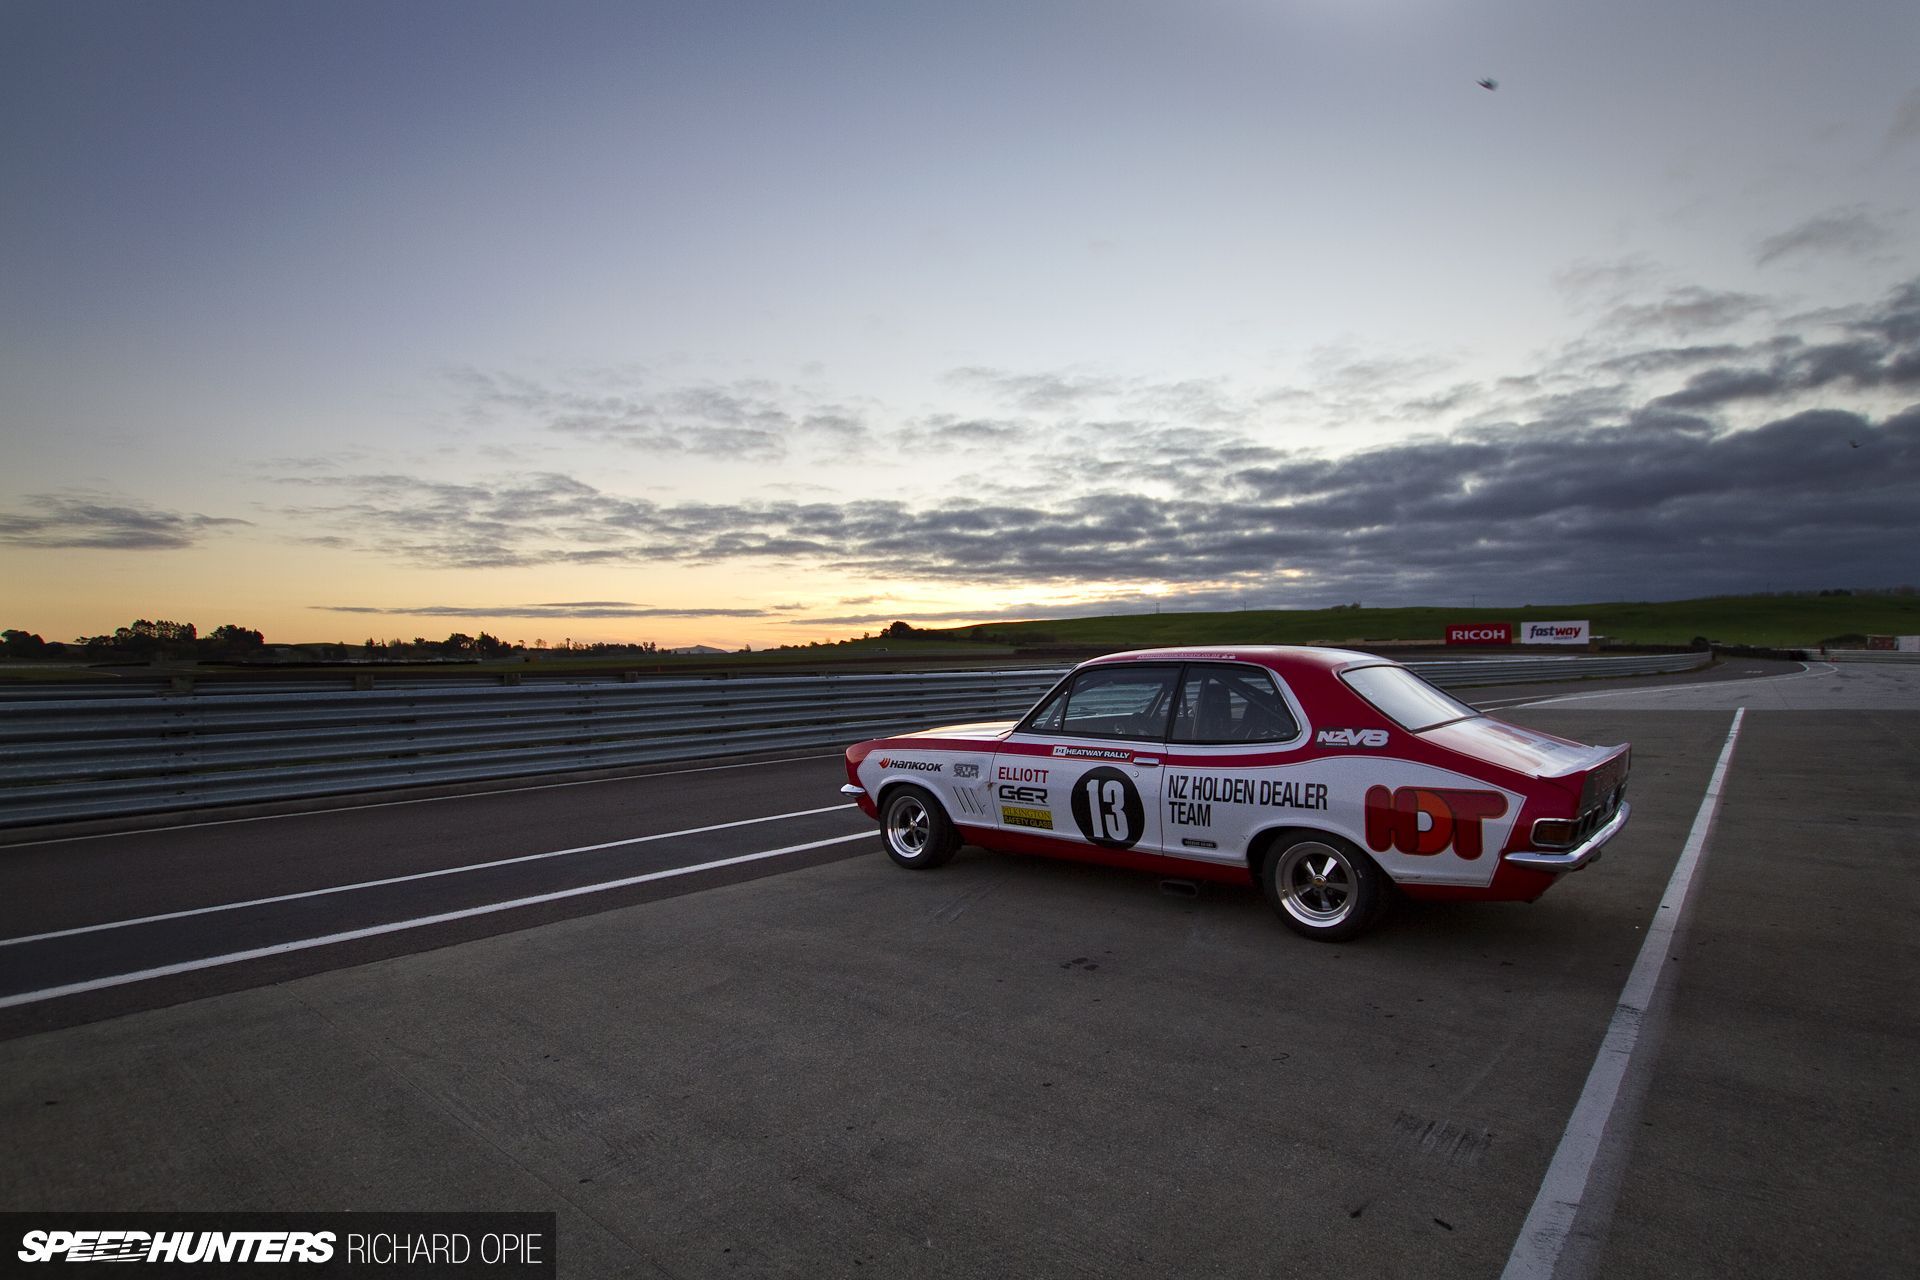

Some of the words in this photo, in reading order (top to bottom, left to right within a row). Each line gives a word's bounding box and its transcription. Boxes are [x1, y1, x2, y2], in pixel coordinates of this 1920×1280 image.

[1452, 629, 1505, 640] RICOH
[1530, 625, 1582, 639] fastway
[1065, 748, 1102, 757] HEATWAY
[1104, 751, 1130, 759] RALLY
[998, 766, 1049, 784] ELLIOTT
[1168, 775, 1189, 799] NZ
[1192, 776, 1255, 804] HOLDEN
[1260, 780, 1328, 810] DEALER
[1086, 779, 1129, 841] 13
[1169, 801, 1211, 827] TEAM
[1365, 784, 1509, 861] HDT
